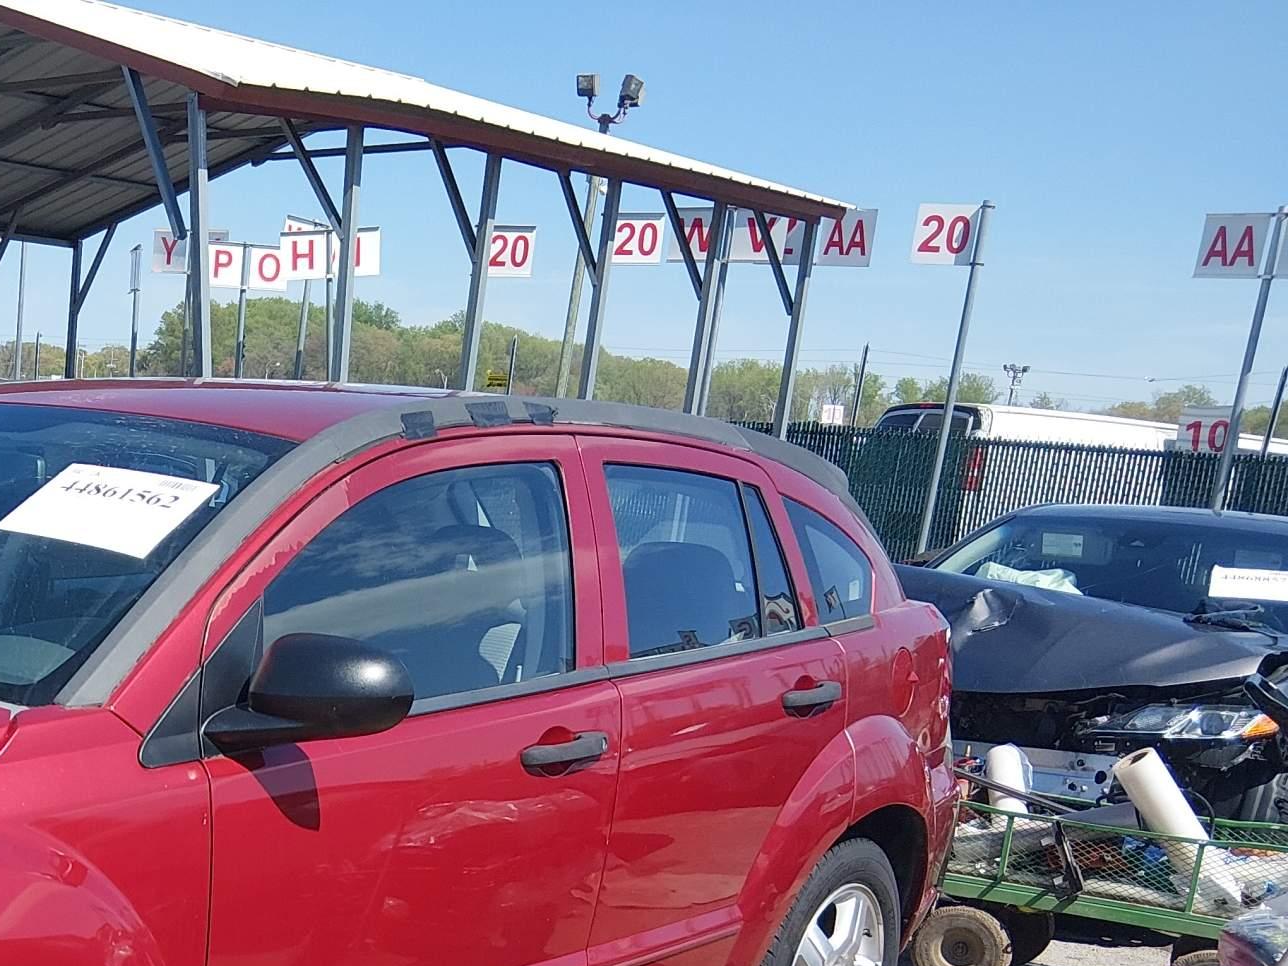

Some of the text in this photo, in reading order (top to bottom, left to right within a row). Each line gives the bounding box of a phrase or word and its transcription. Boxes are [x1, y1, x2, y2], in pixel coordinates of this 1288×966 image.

[614, 222, 658, 257] 20
[823, 218, 866, 256] AA
[917, 214, 971, 254] 20
[1202, 225, 1255, 267] AA
[161, 236, 179, 266] Y
[213, 249, 233, 279] P
[292, 239, 315, 272] H
[489, 234, 530, 268] 20
[258, 253, 281, 283] O
[1186, 420, 1230, 452] 10
[60, 480, 181, 509] 44861562
